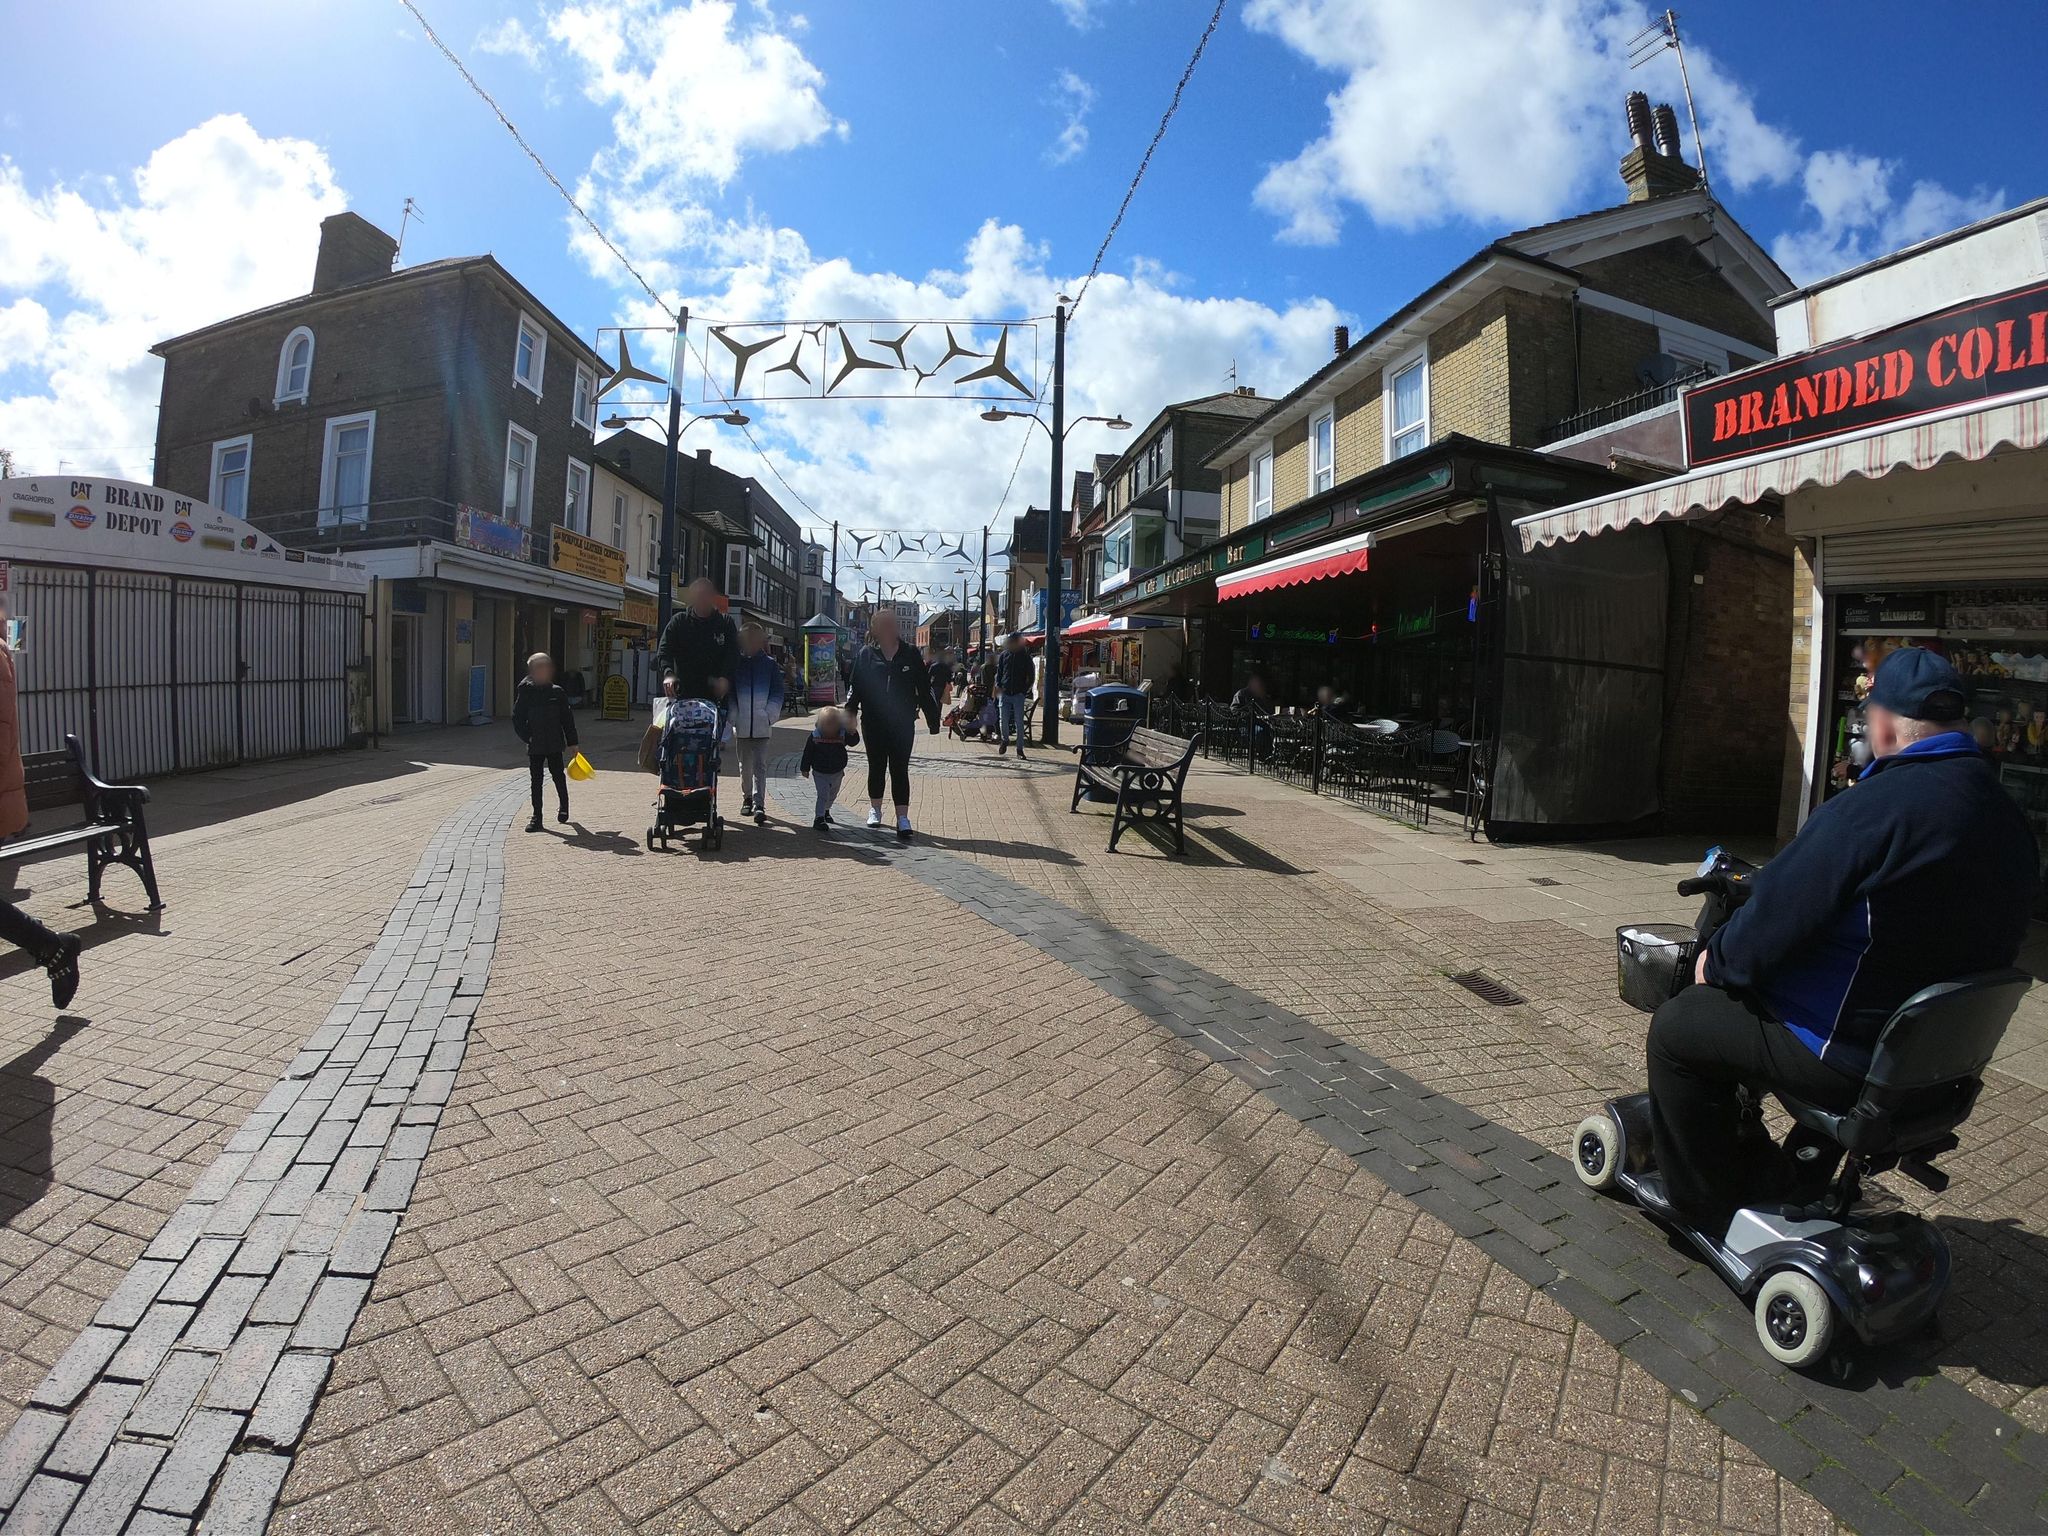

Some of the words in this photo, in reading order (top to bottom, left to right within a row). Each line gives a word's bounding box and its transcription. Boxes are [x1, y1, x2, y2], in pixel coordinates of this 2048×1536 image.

[1712, 348, 1914, 442] BRANDED
[12, 492, 55, 504] CRAGHOPPERS
[70, 481, 92, 500] CAT
[105, 485, 165, 512] BRAND
[174, 500, 192, 517] CAT
[106, 511, 162, 536] DEPOT
[1226, 545, 1245, 564] Bar
